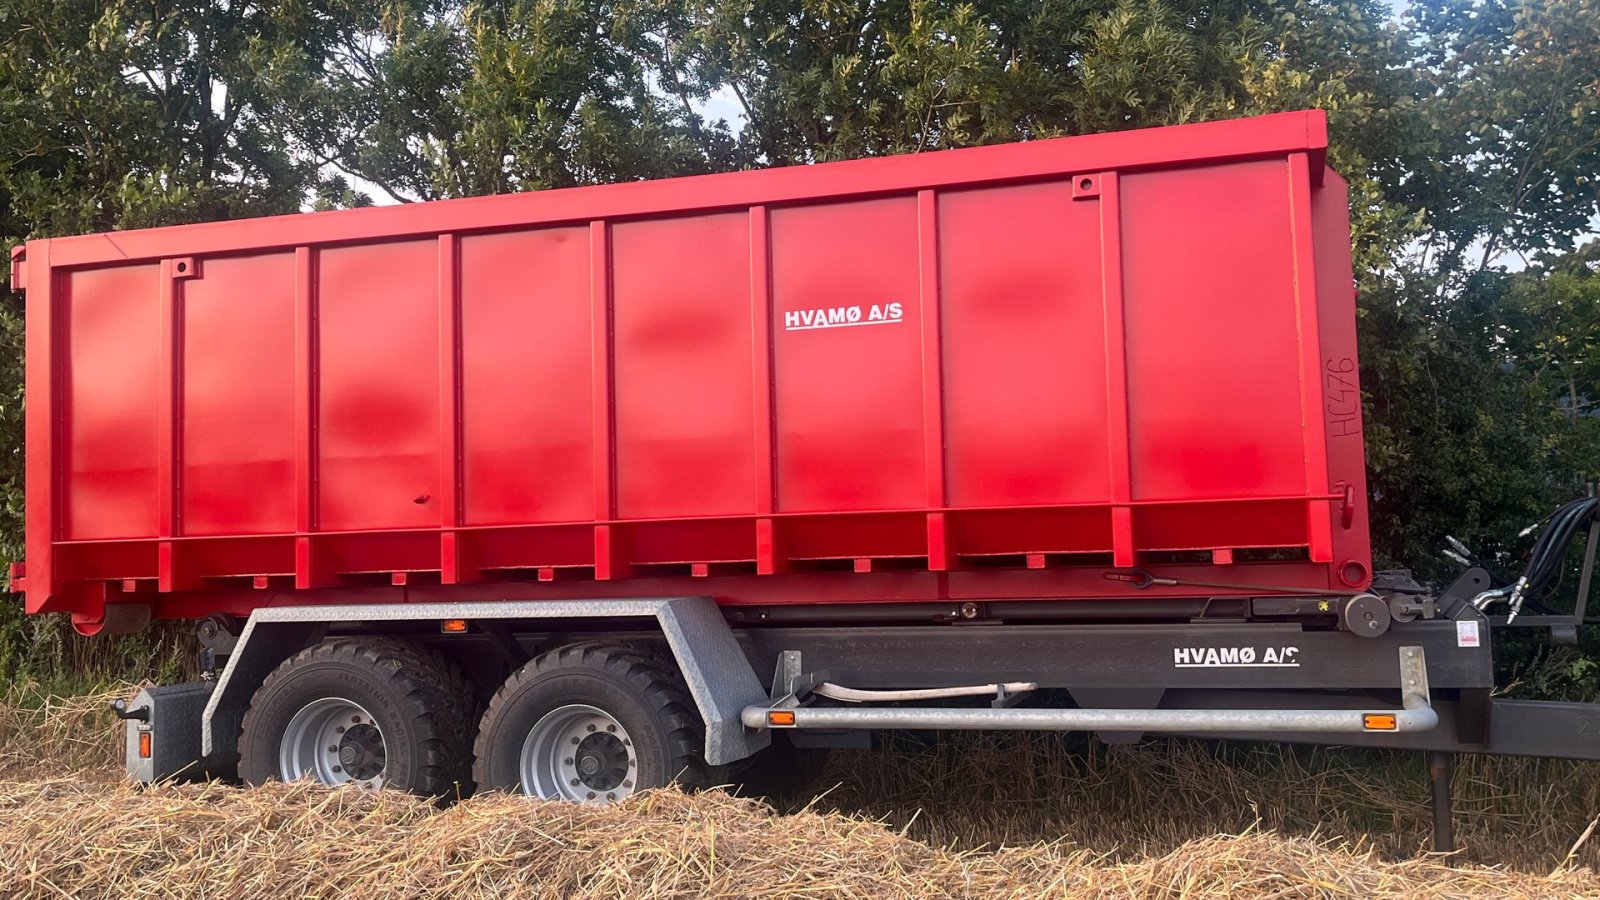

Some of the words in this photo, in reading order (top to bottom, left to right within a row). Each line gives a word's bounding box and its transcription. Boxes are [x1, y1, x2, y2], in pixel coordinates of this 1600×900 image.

[785, 305, 861, 328] HVAMØ
[868, 302, 903, 321] A/S
[1326, 358, 1360, 437] HC476
[1173, 646, 1256, 665] HVAMØ
